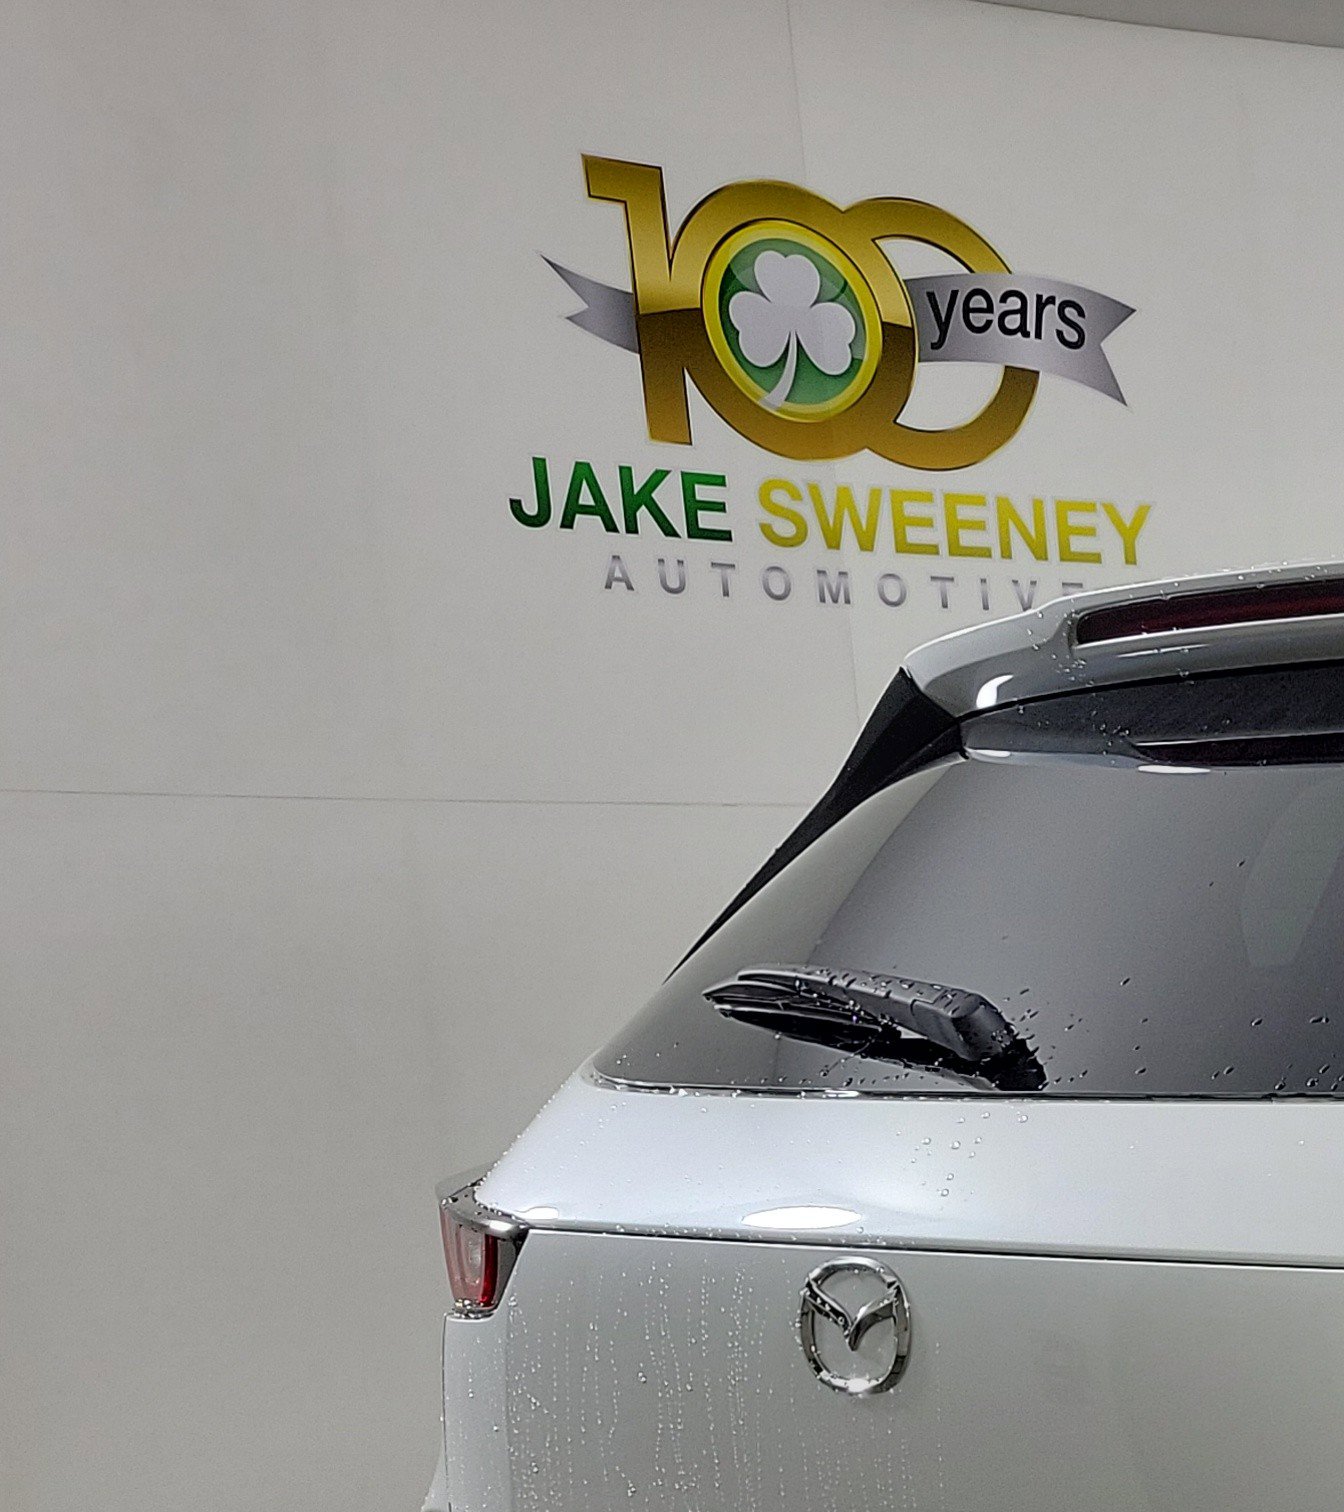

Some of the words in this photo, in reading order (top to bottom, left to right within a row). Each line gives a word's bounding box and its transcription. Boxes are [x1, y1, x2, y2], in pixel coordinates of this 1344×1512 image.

[582, 154, 1041, 470] 100
[925, 284, 1088, 351] years
[509, 456, 734, 543] JAKE
[757, 478, 1152, 566] SWEENEY
